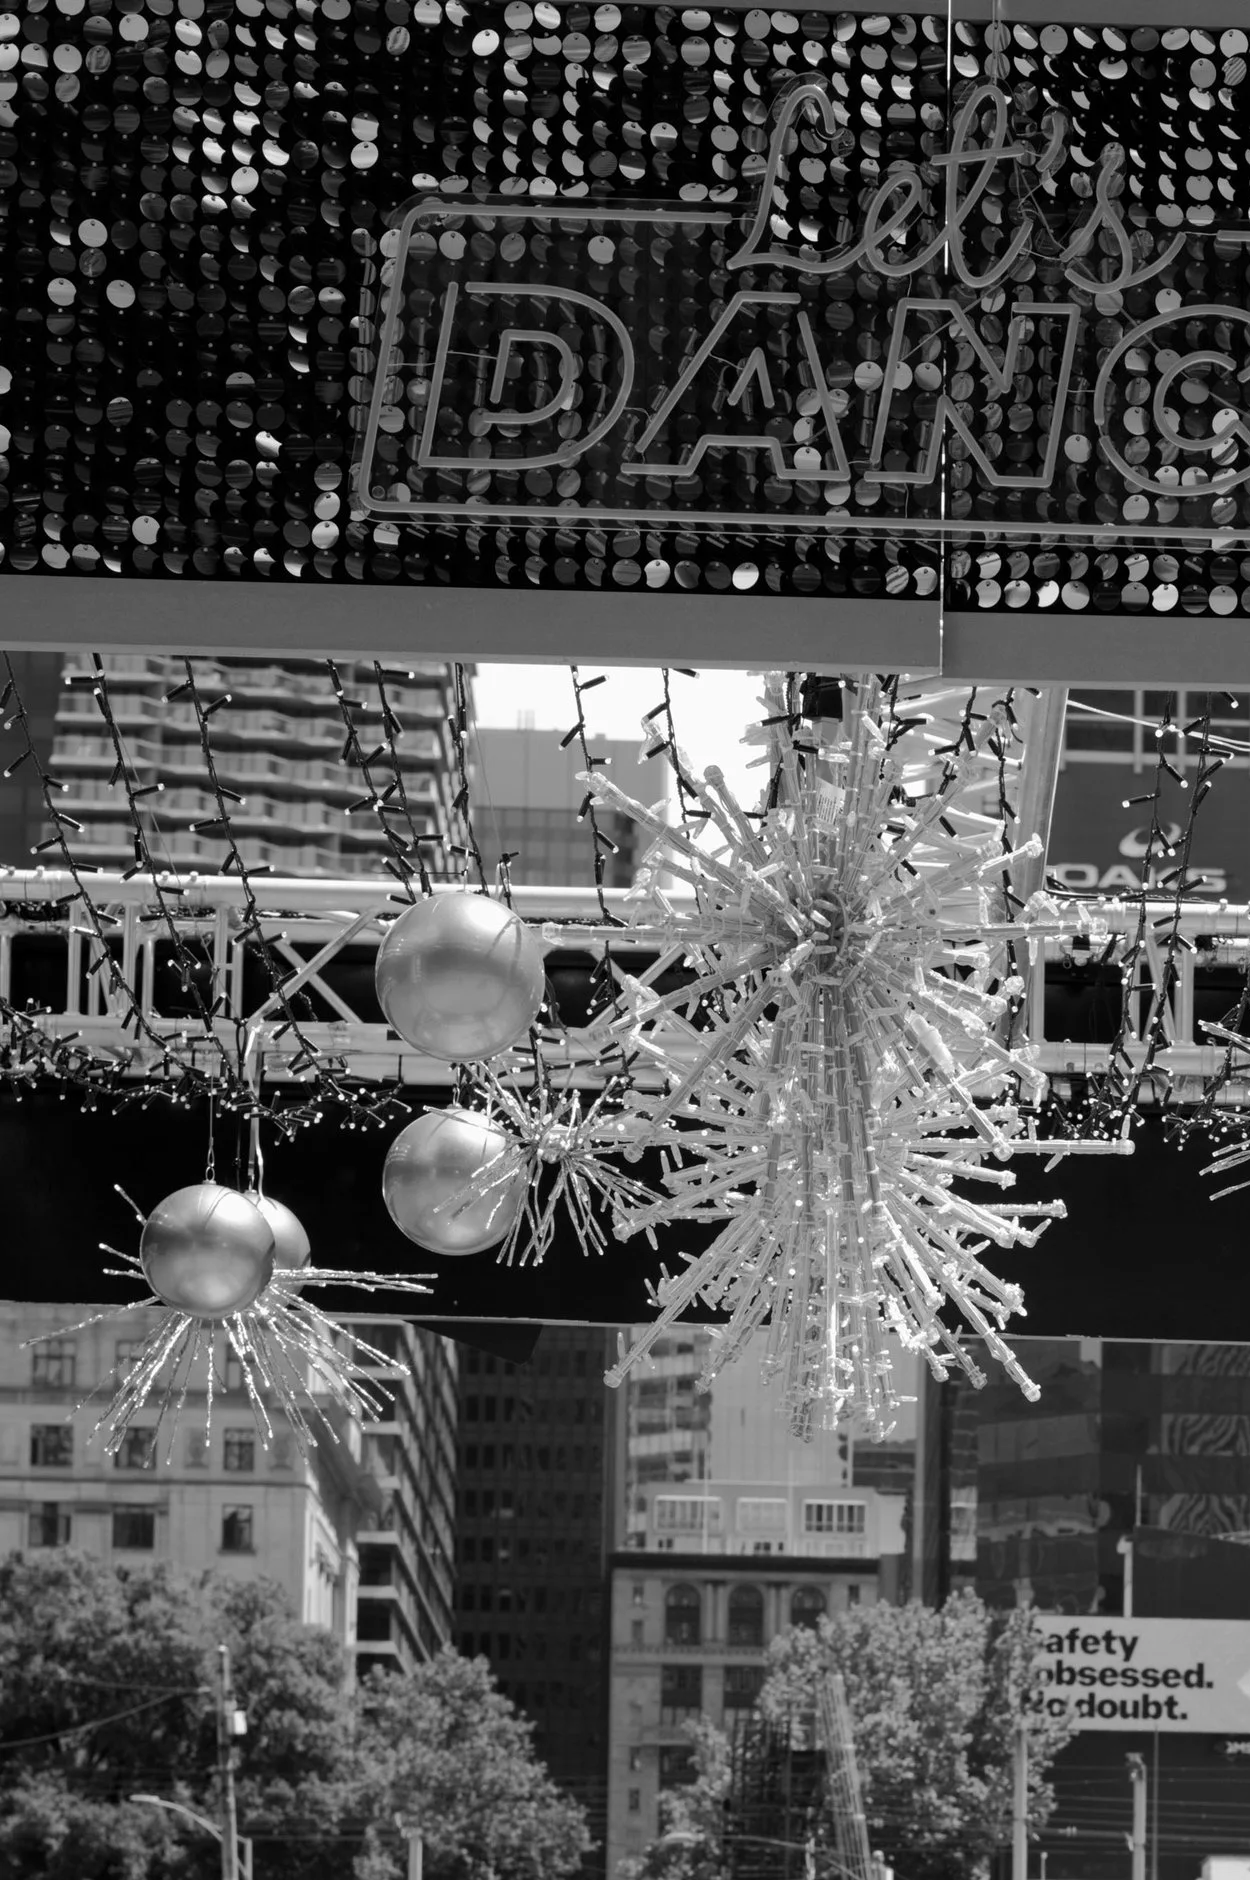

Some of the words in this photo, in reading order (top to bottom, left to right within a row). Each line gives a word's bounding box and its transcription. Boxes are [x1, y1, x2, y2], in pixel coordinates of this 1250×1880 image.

[727, 81, 1185, 295] Let's
[1052, 862, 1228, 893] OAKS
[1036, 1660, 1214, 1689] obsessed.
[1075, 1693, 1188, 1720] doubt.
